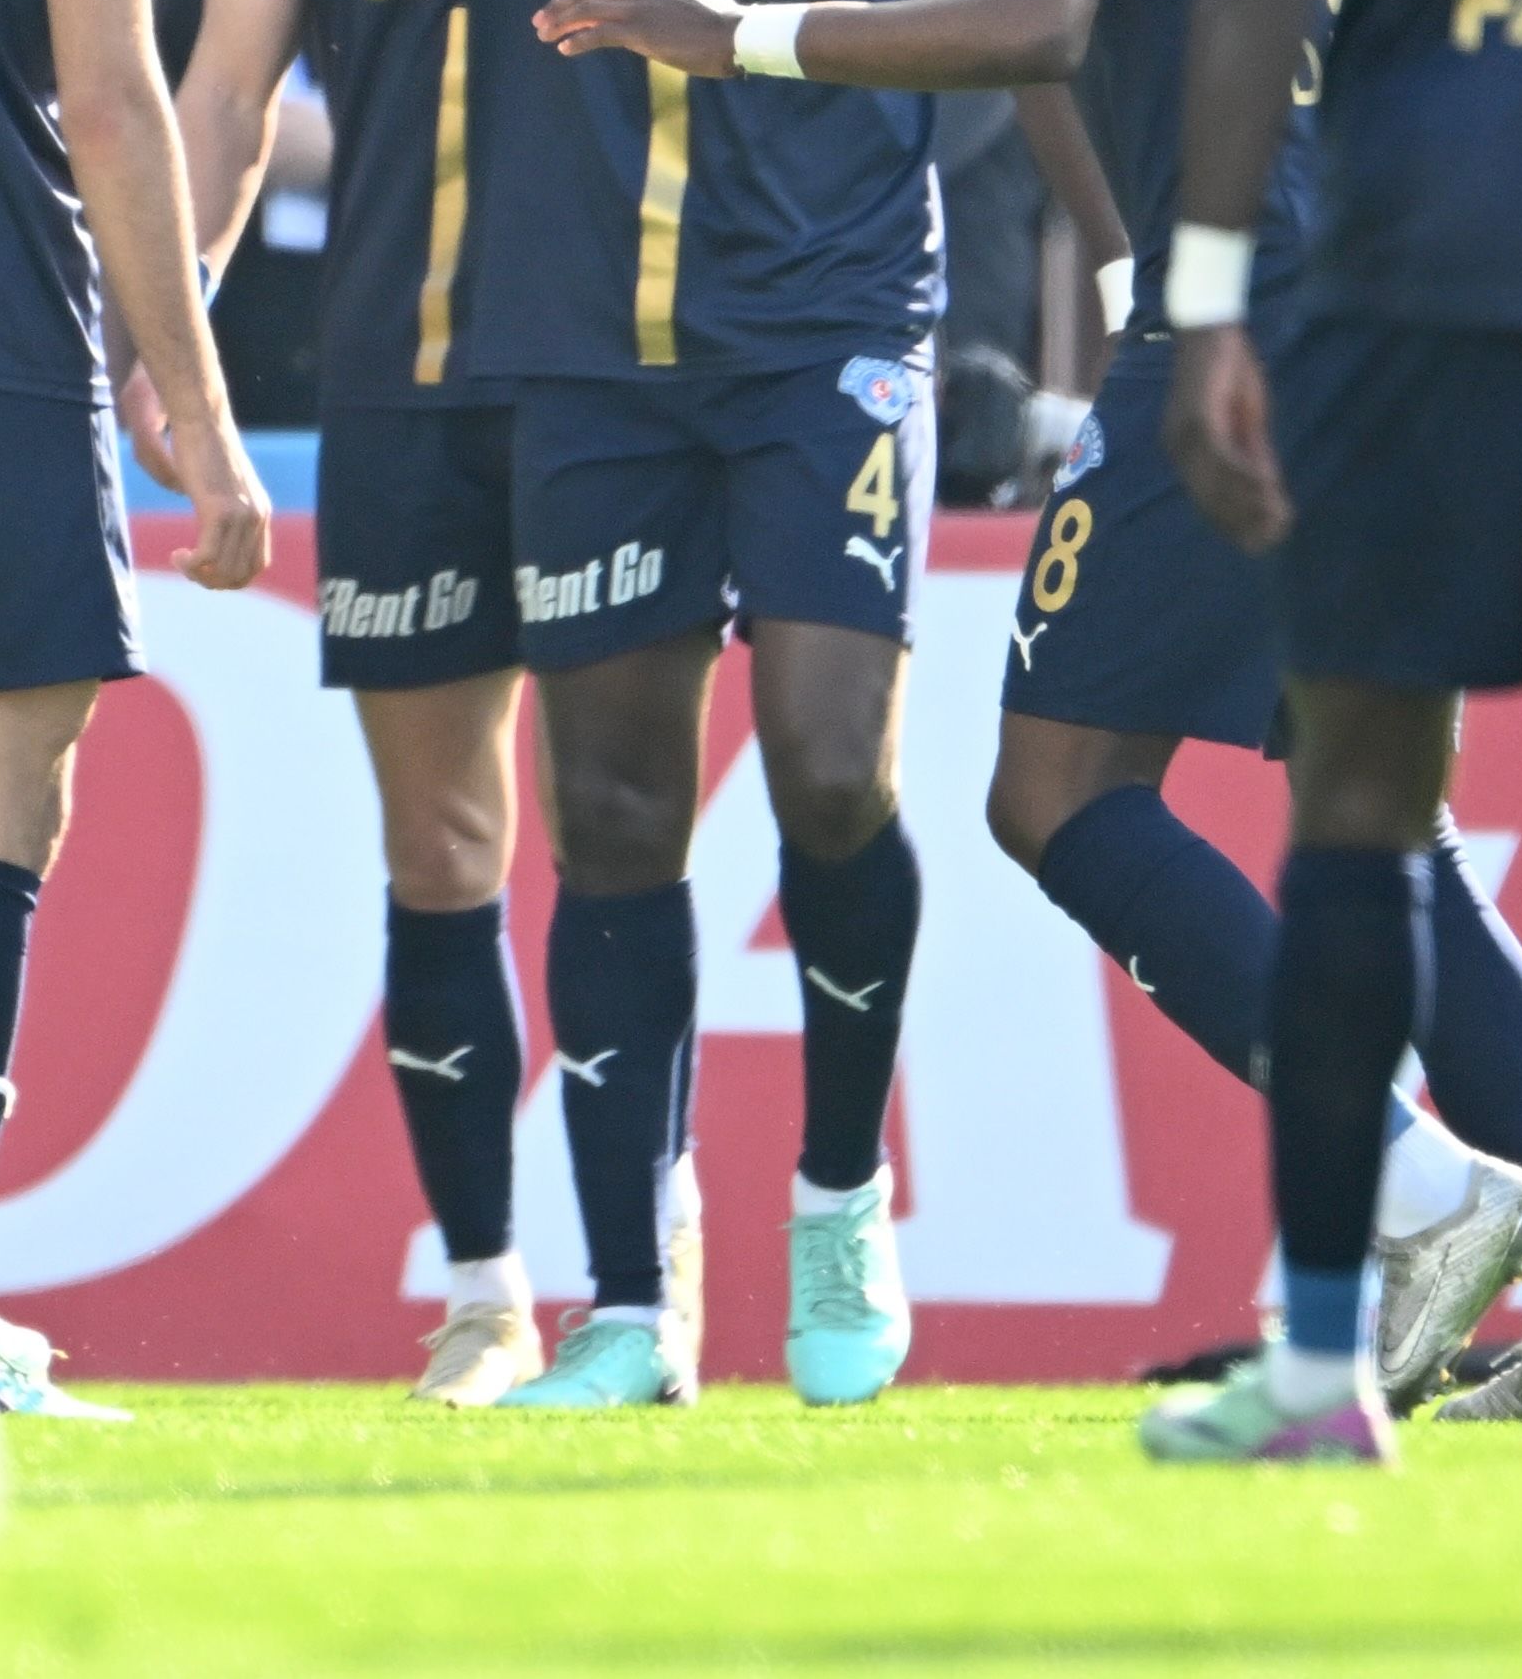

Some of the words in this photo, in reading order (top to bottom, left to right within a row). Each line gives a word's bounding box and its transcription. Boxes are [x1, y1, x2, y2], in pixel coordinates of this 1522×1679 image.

[846, 431, 899, 537] 4
[609, 541, 664, 606] Go
[1034, 498, 1092, 612] 8
[424, 569, 478, 632] Go
